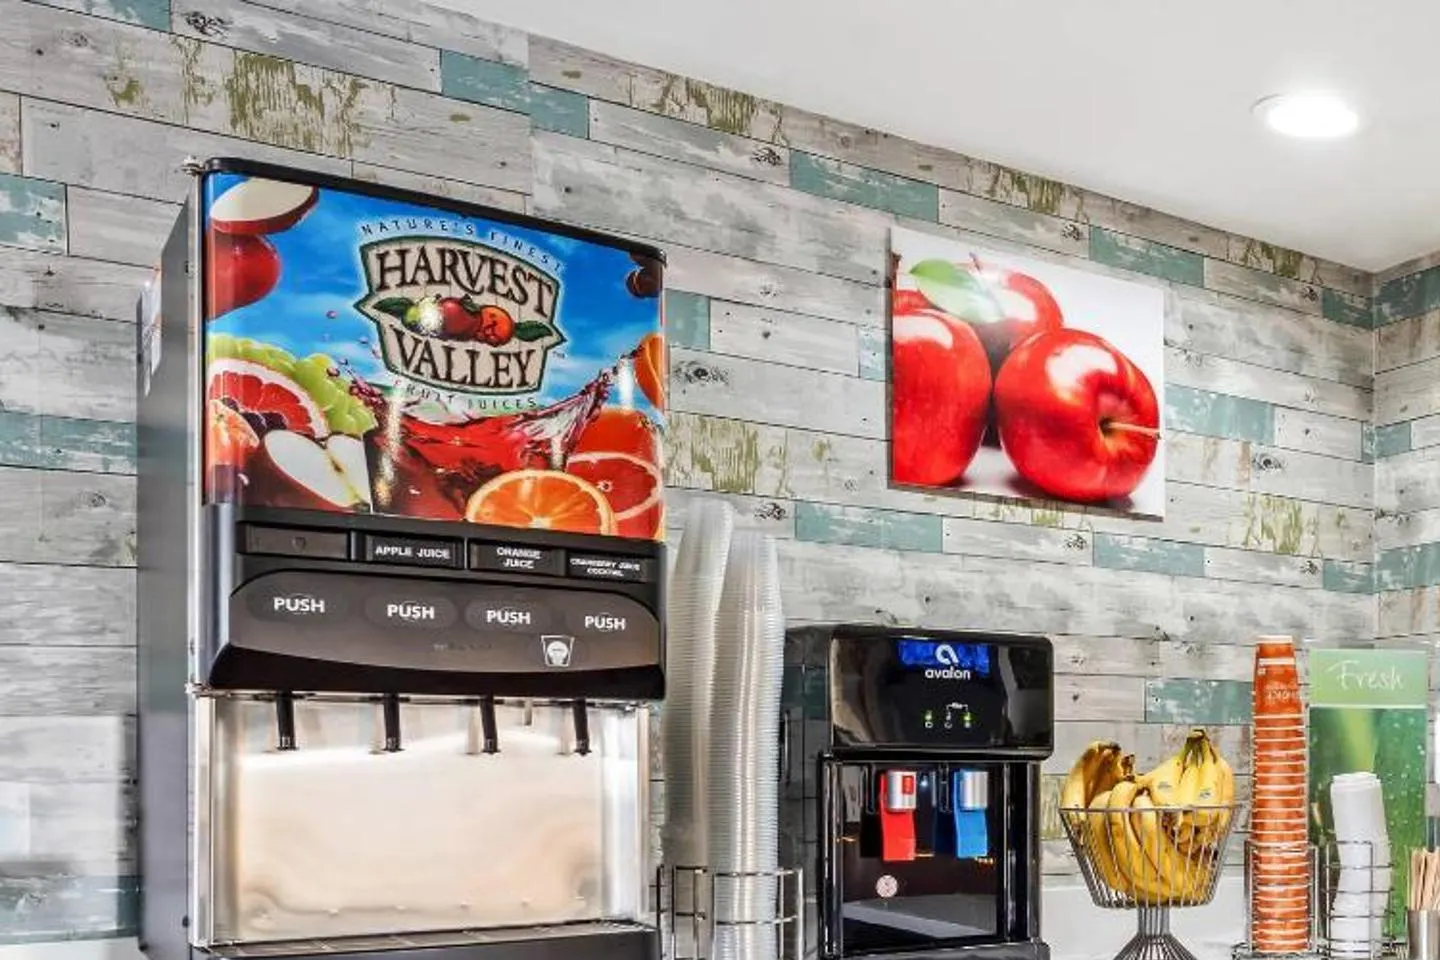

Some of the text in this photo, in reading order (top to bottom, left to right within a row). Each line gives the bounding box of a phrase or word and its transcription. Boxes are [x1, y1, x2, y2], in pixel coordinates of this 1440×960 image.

[361, 218, 475, 235] NATURE'S
[374, 244, 555, 318] HARVEST
[389, 324, 536, 388] VALLEY
[468, 396, 537, 411] JUICES
[374, 545, 450, 560] APPLE JUICE
[496, 547, 542, 560] ORANGE
[503, 558, 534, 569] JUICE
[273, 596, 326, 614] PUSH
[387, 604, 435, 620] PUSH
[487, 609, 531, 625] PUSH
[584, 614, 626, 631] PUSH
[924, 665, 971, 680] avalon
[1326, 660, 1405, 690] Fresh
